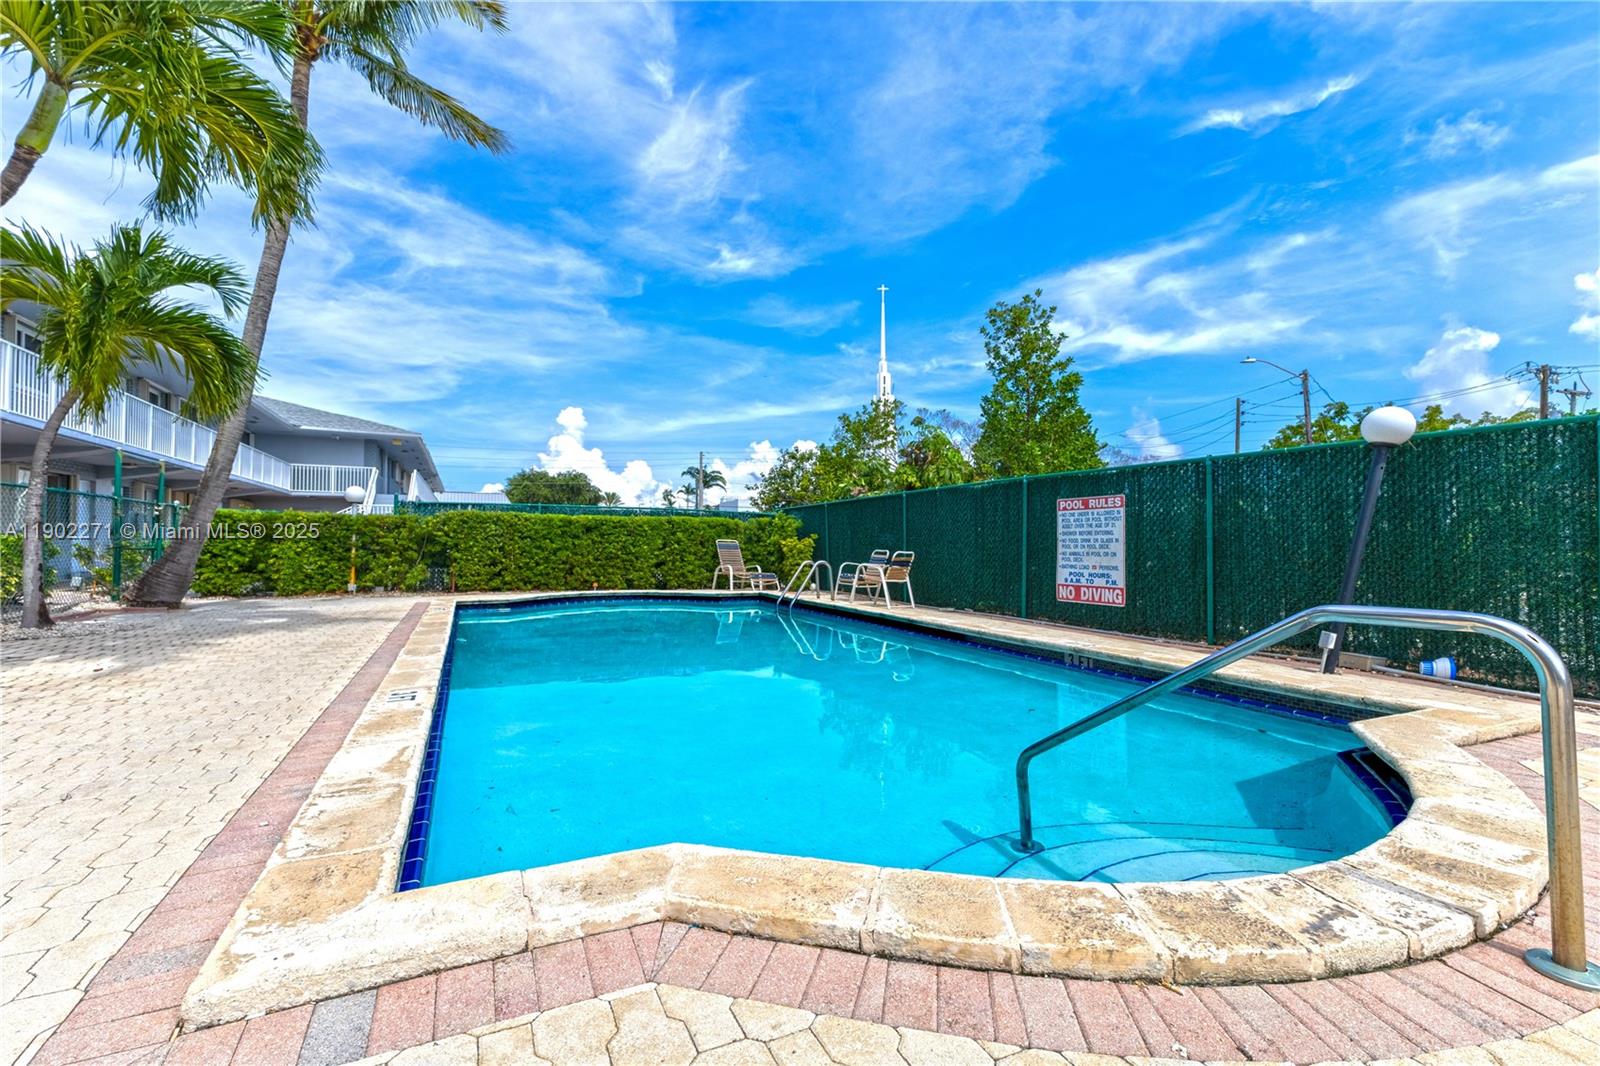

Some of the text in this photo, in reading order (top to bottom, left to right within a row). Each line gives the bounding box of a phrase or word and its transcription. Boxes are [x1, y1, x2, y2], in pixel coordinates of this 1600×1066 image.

[1060, 498, 1122, 510] POOL RULES
[1059, 586, 1122, 604] NO DIVING
